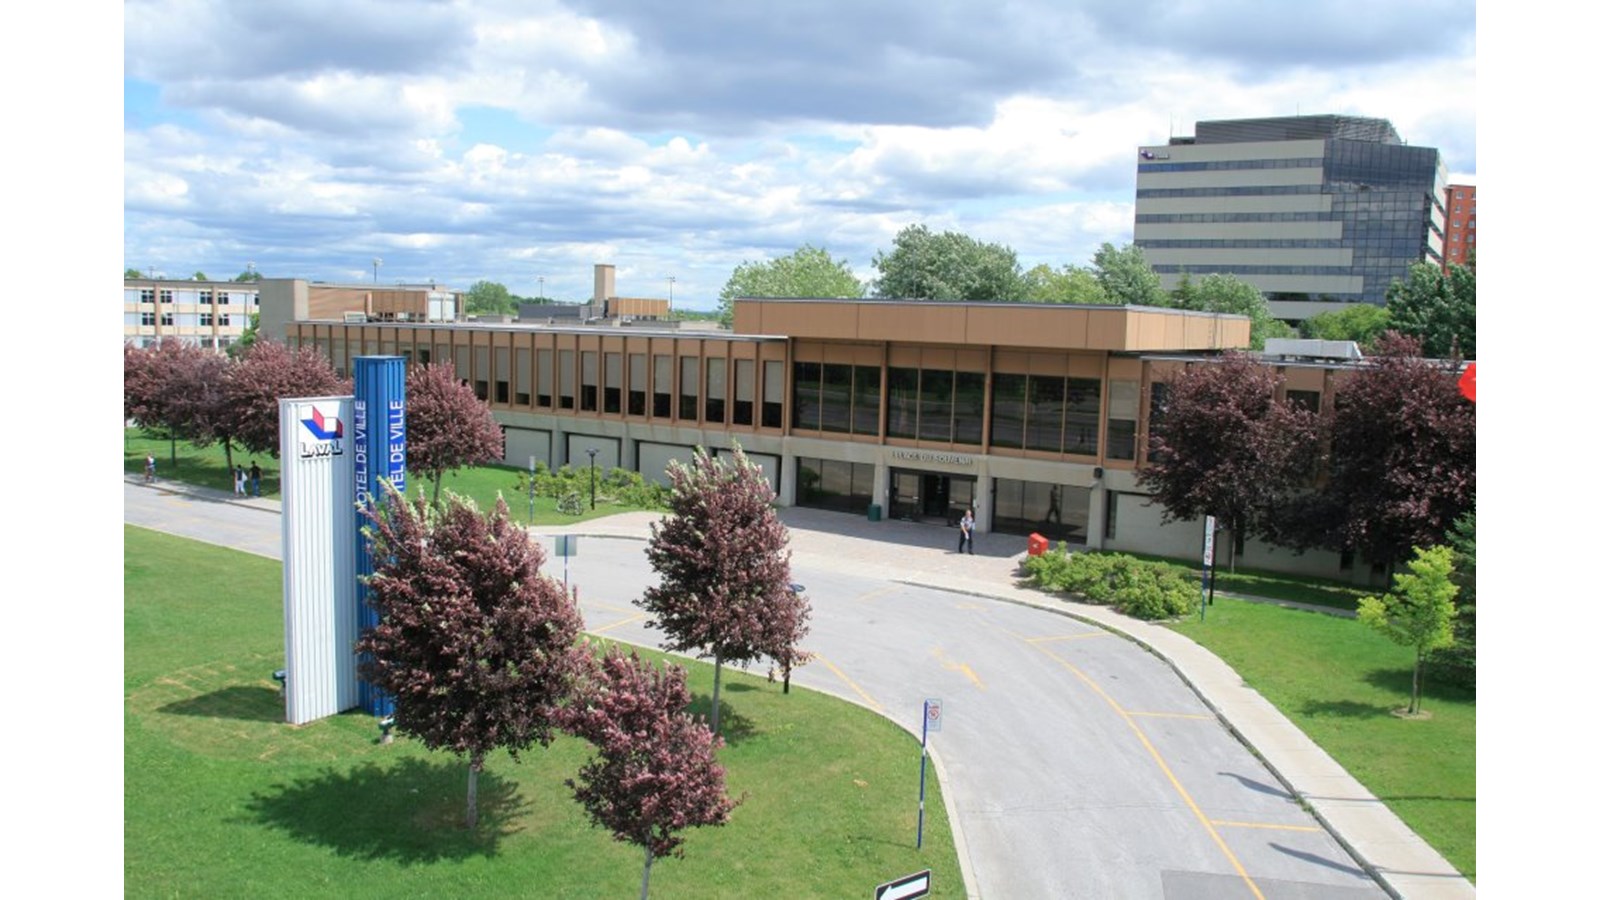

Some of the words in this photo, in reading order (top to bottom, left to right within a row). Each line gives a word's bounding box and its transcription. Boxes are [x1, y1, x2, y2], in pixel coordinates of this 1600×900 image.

[355, 401, 366, 440] VILLE
[390, 401, 404, 440] VILLE
[300, 440, 343, 458] LAVAL
[355, 444, 367, 463] DE
[390, 443, 404, 463] DE
